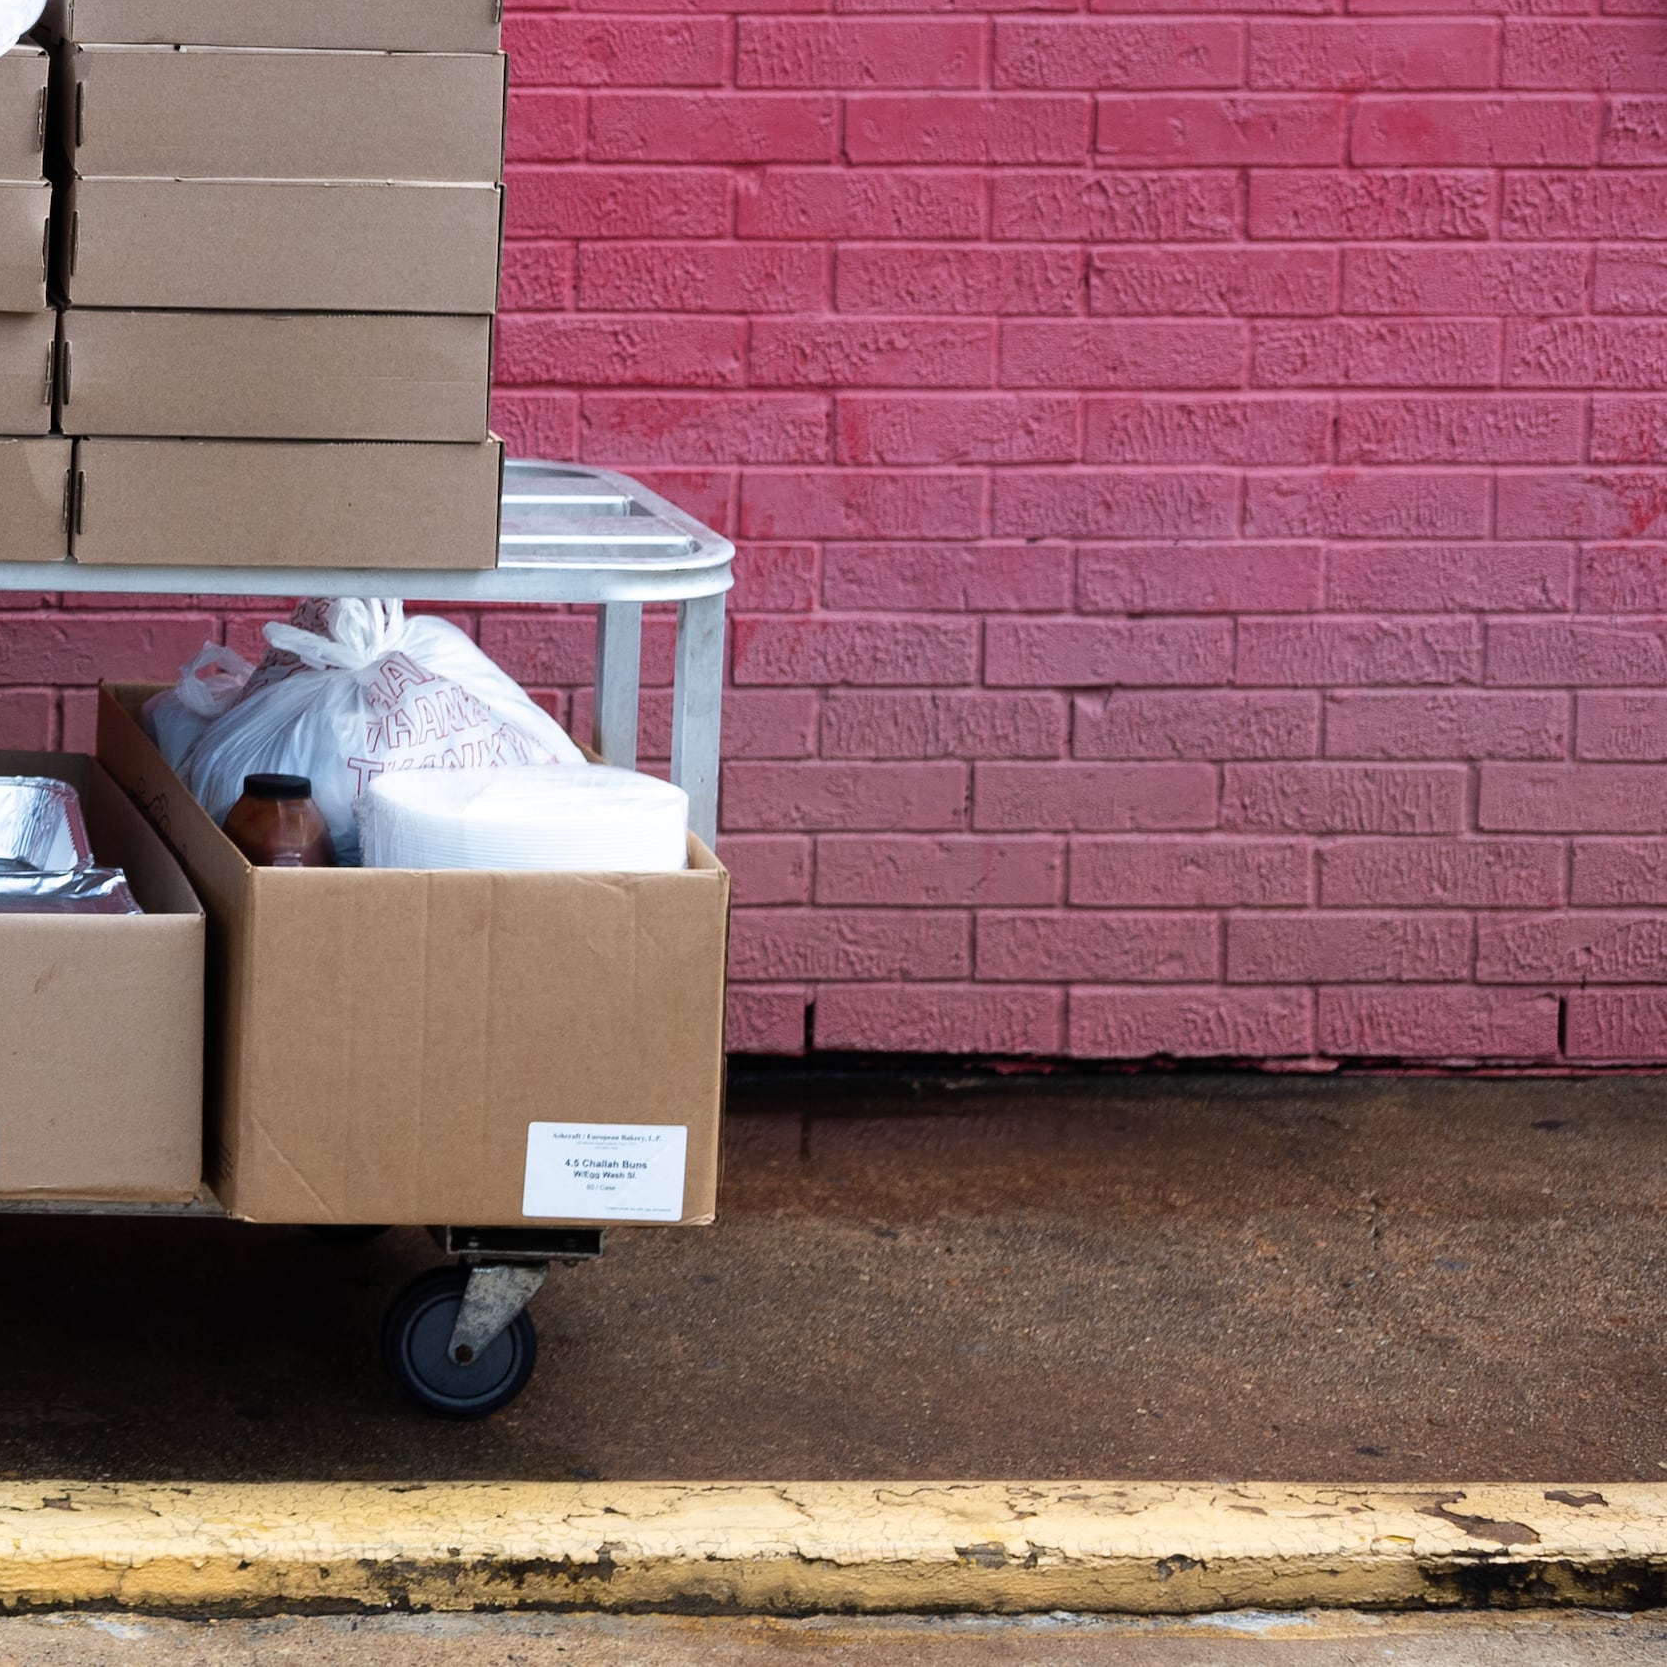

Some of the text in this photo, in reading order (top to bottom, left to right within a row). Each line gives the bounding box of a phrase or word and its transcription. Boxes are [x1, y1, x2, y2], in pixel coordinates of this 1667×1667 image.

[582, 1159, 619, 1169] Challah
[622, 1160, 647, 1169] Buns
[603, 1171, 625, 1179] Wash
